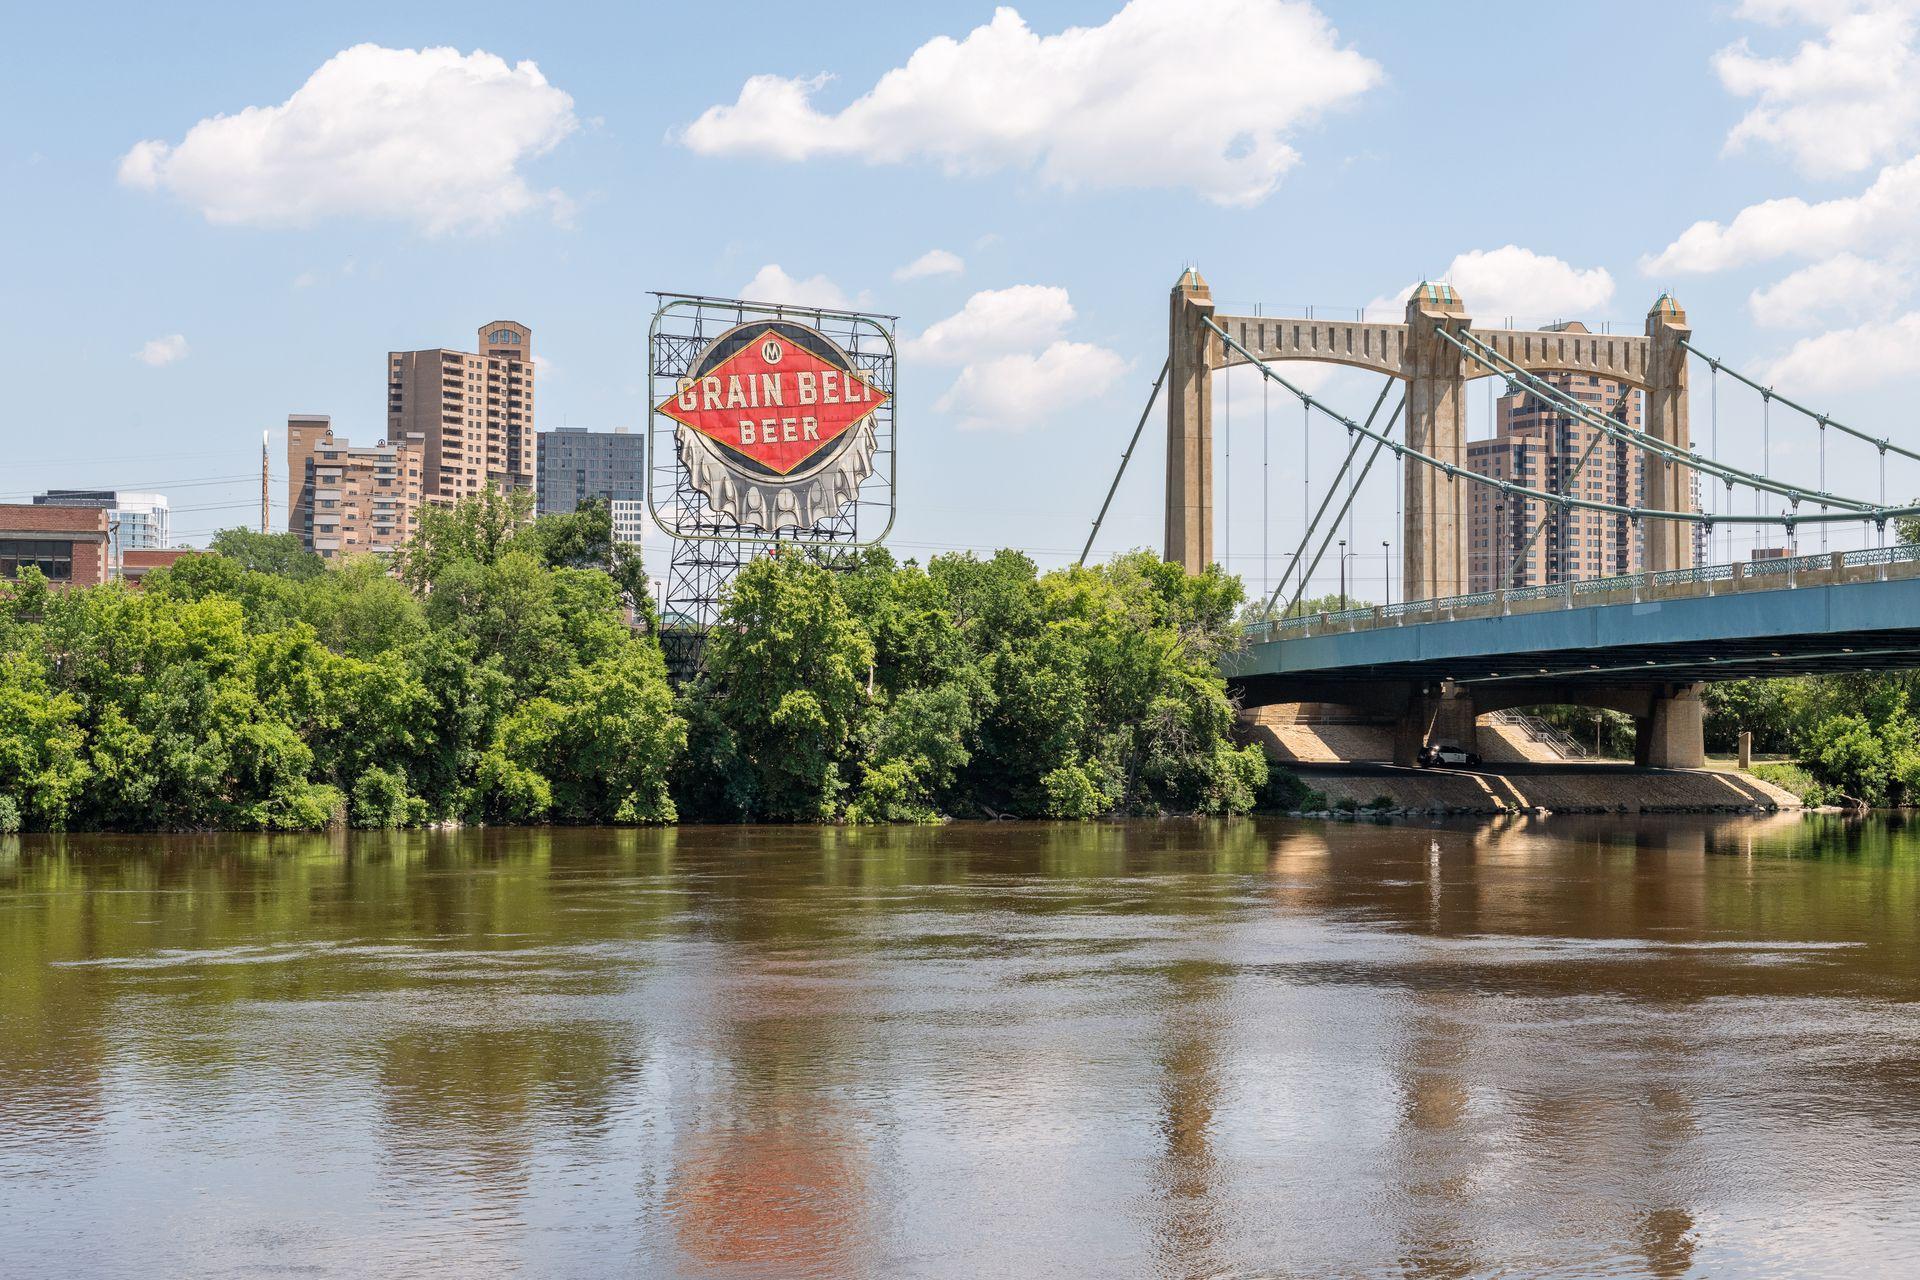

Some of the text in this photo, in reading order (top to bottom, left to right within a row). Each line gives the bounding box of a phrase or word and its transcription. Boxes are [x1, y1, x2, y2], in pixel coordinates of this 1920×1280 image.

[676, 369, 874, 411] GRAIN BELT
[739, 416, 820, 445] BEER
